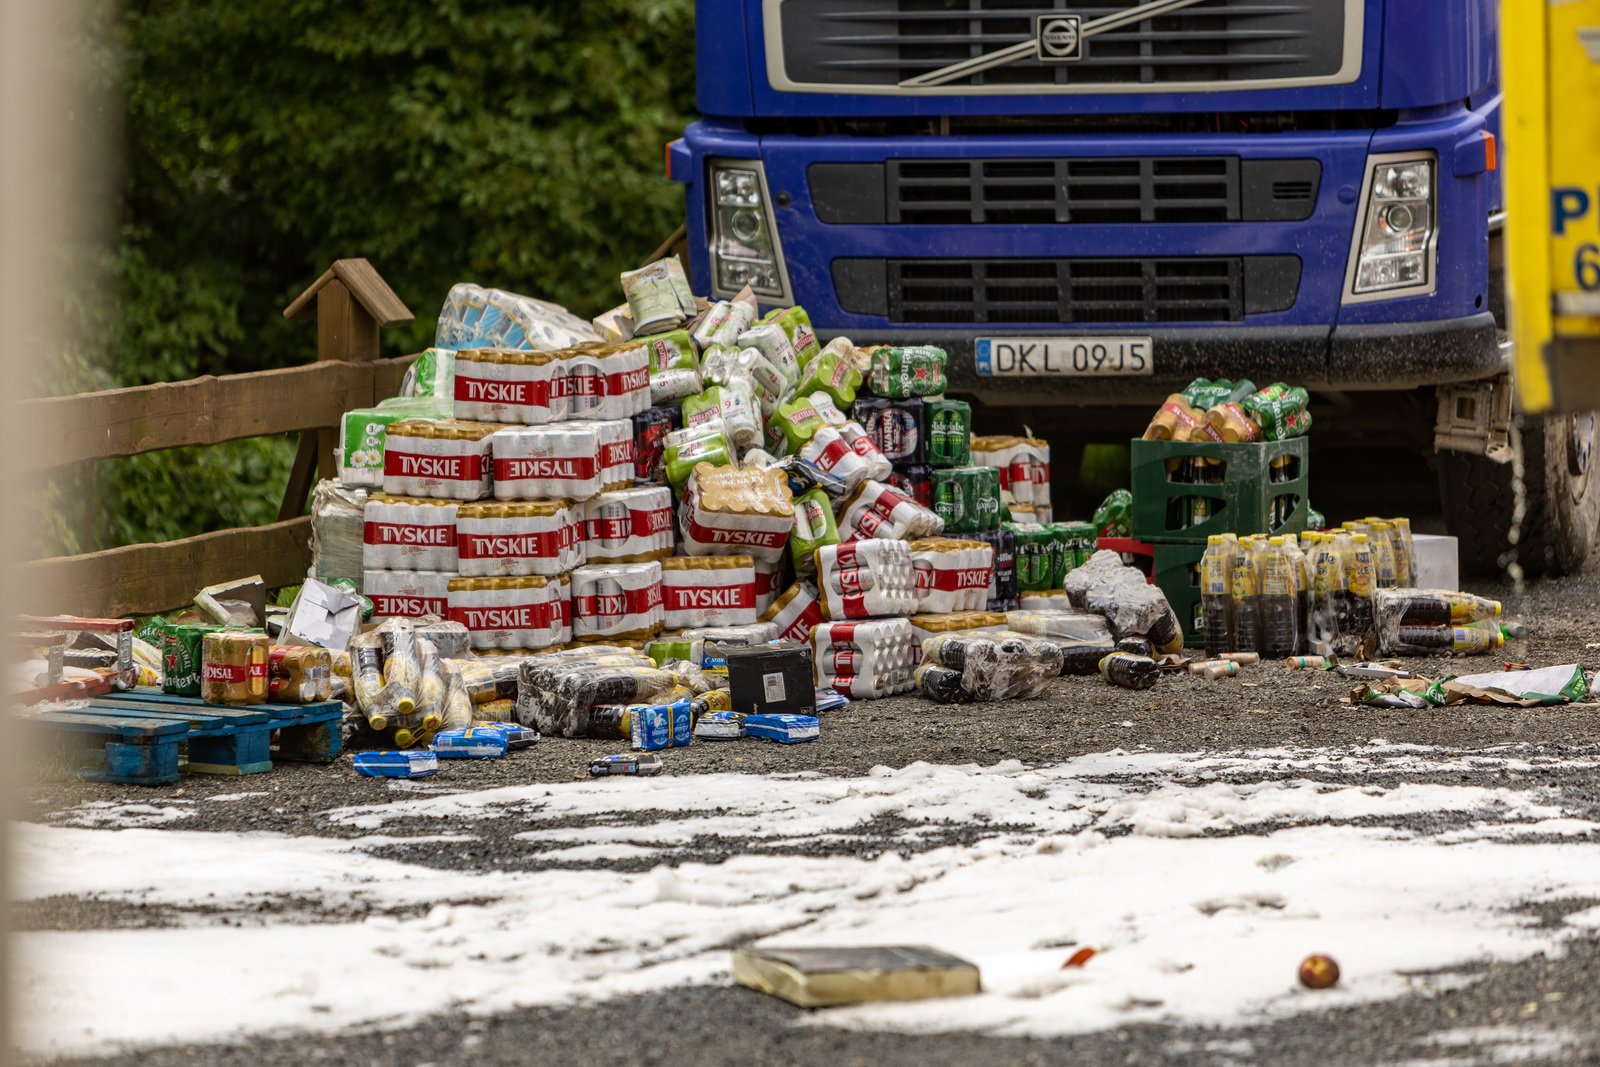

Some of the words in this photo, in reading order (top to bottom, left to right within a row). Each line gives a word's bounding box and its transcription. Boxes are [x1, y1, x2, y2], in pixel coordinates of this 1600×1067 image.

[1551, 186, 1600, 237] P
[997, 344, 1060, 372] DKL
[1073, 344, 1146, 372] 09J5
[621, 368, 647, 390] TYSKIE
[466, 380, 526, 402] TYSKIE
[1271, 400, 1286, 440] Heinek
[883, 409, 892, 452] WARKA
[399, 456, 460, 476] TYSKIE
[509, 460, 577, 477] TYSKIE
[378, 526, 447, 543] TYSKIE
[712, 529, 776, 545] TYSKIE
[472, 537, 538, 555] TYSKIE
[957, 570, 988, 587] TYSKIE
[378, 598, 446, 617] TYSKIE
[675, 588, 741, 607] TYSKIE
[464, 608, 531, 628] TYSKIE
